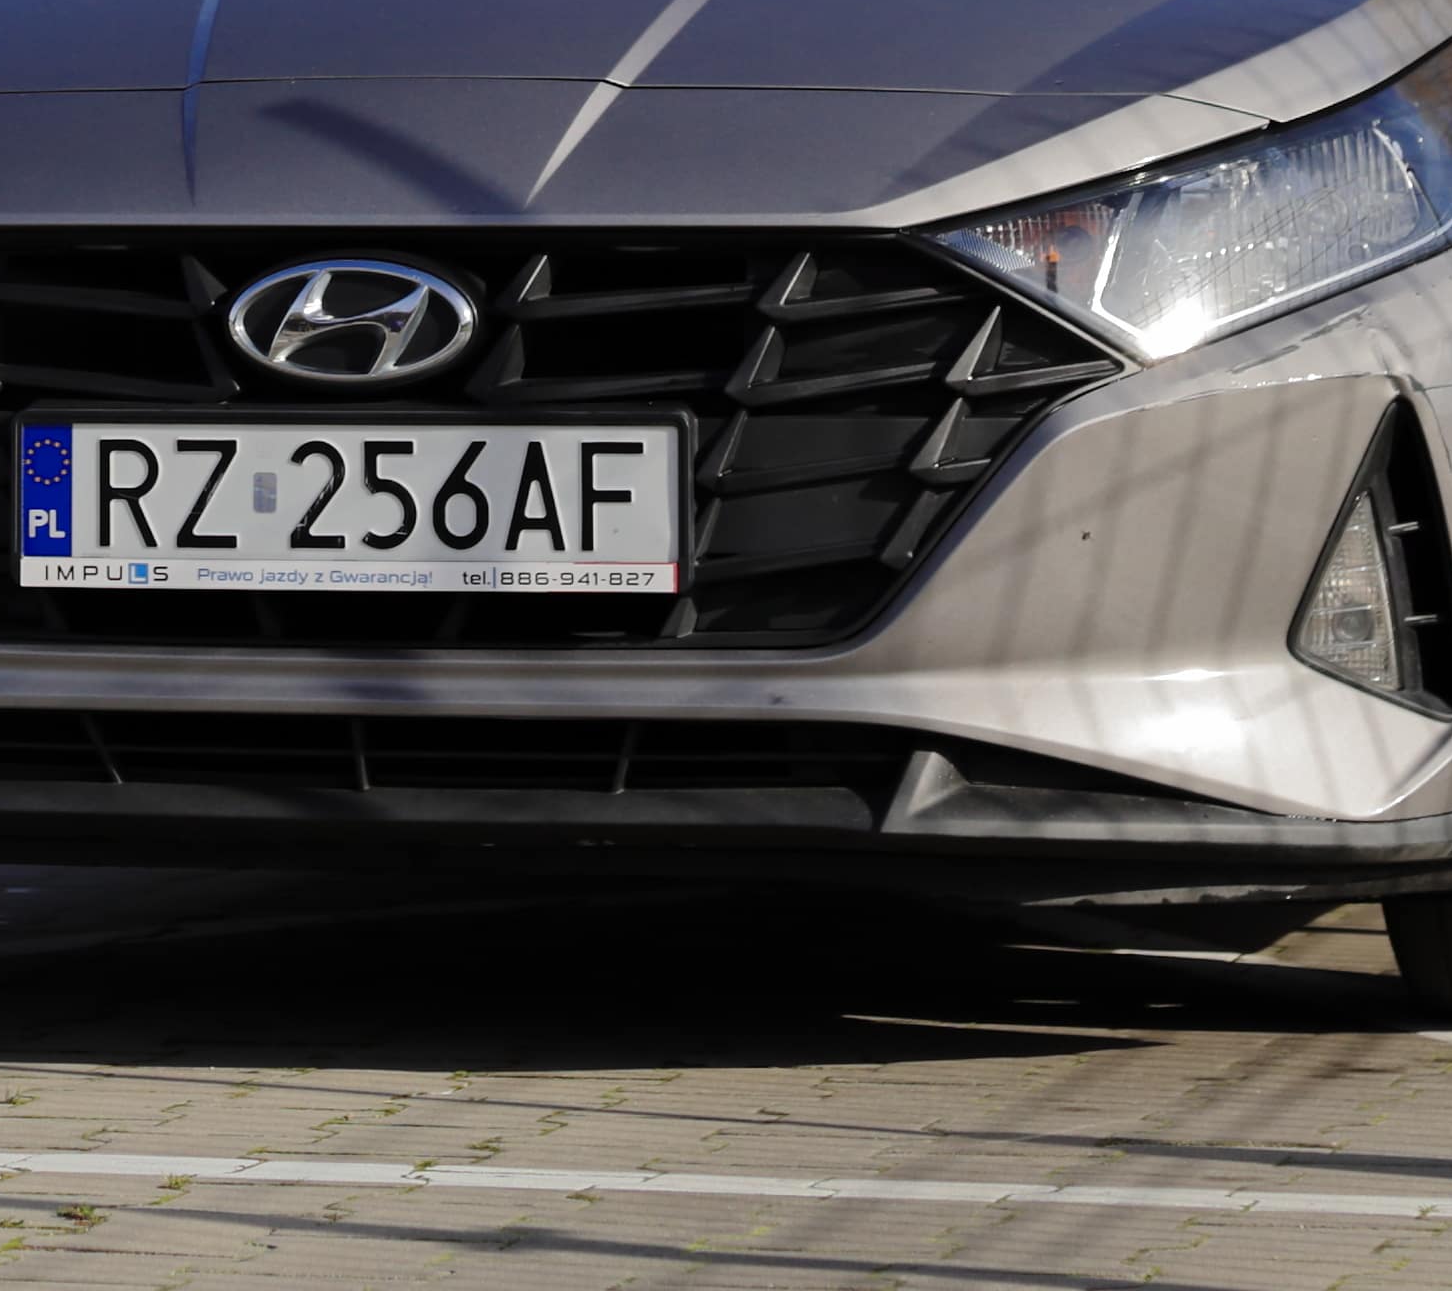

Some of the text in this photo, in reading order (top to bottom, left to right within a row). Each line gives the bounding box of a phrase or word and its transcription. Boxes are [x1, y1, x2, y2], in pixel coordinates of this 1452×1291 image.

[99, 438, 644, 551] RZ 256AF
[28, 509, 66, 539] PL
[44, 563, 169, 585] IMPULS
[196, 568, 254, 582] Prawo
[315, 572, 324, 584] z
[329, 569, 434, 589] Gwarancją!
[462, 570, 492, 586] tel.
[500, 571, 656, 587] 886-941-827
